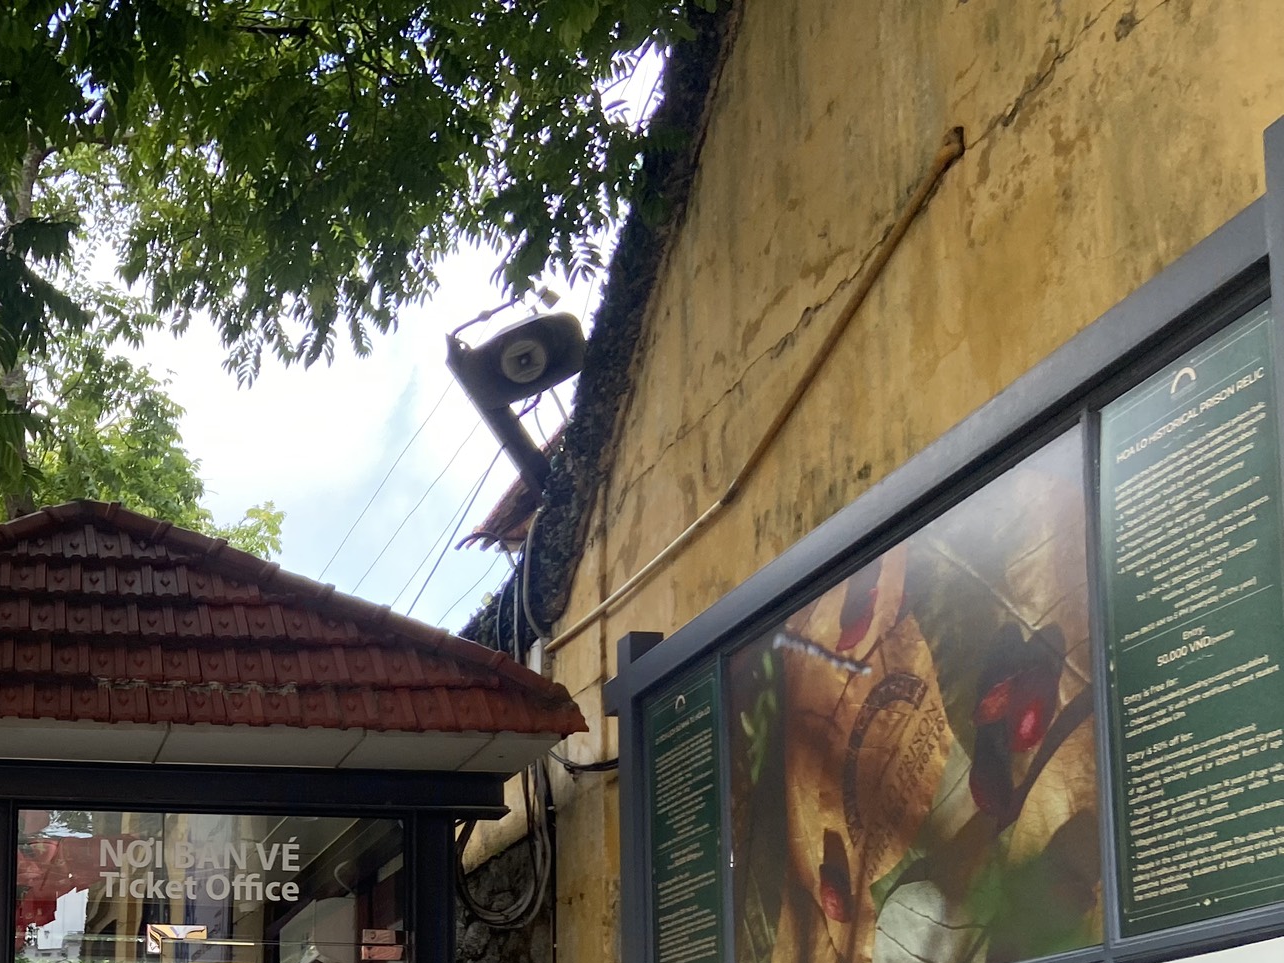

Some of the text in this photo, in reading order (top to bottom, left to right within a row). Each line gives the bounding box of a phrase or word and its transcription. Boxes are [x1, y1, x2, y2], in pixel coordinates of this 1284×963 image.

[1147, 408, 1199, 446] HISTORICAL
[1199, 384, 1235, 413] PRISON
[1236, 366, 1265, 392] RELIC
[99, 838, 163, 869] NƠI
[256, 836, 301, 872] VÉ
[100, 871, 300, 902] Ticket Office
